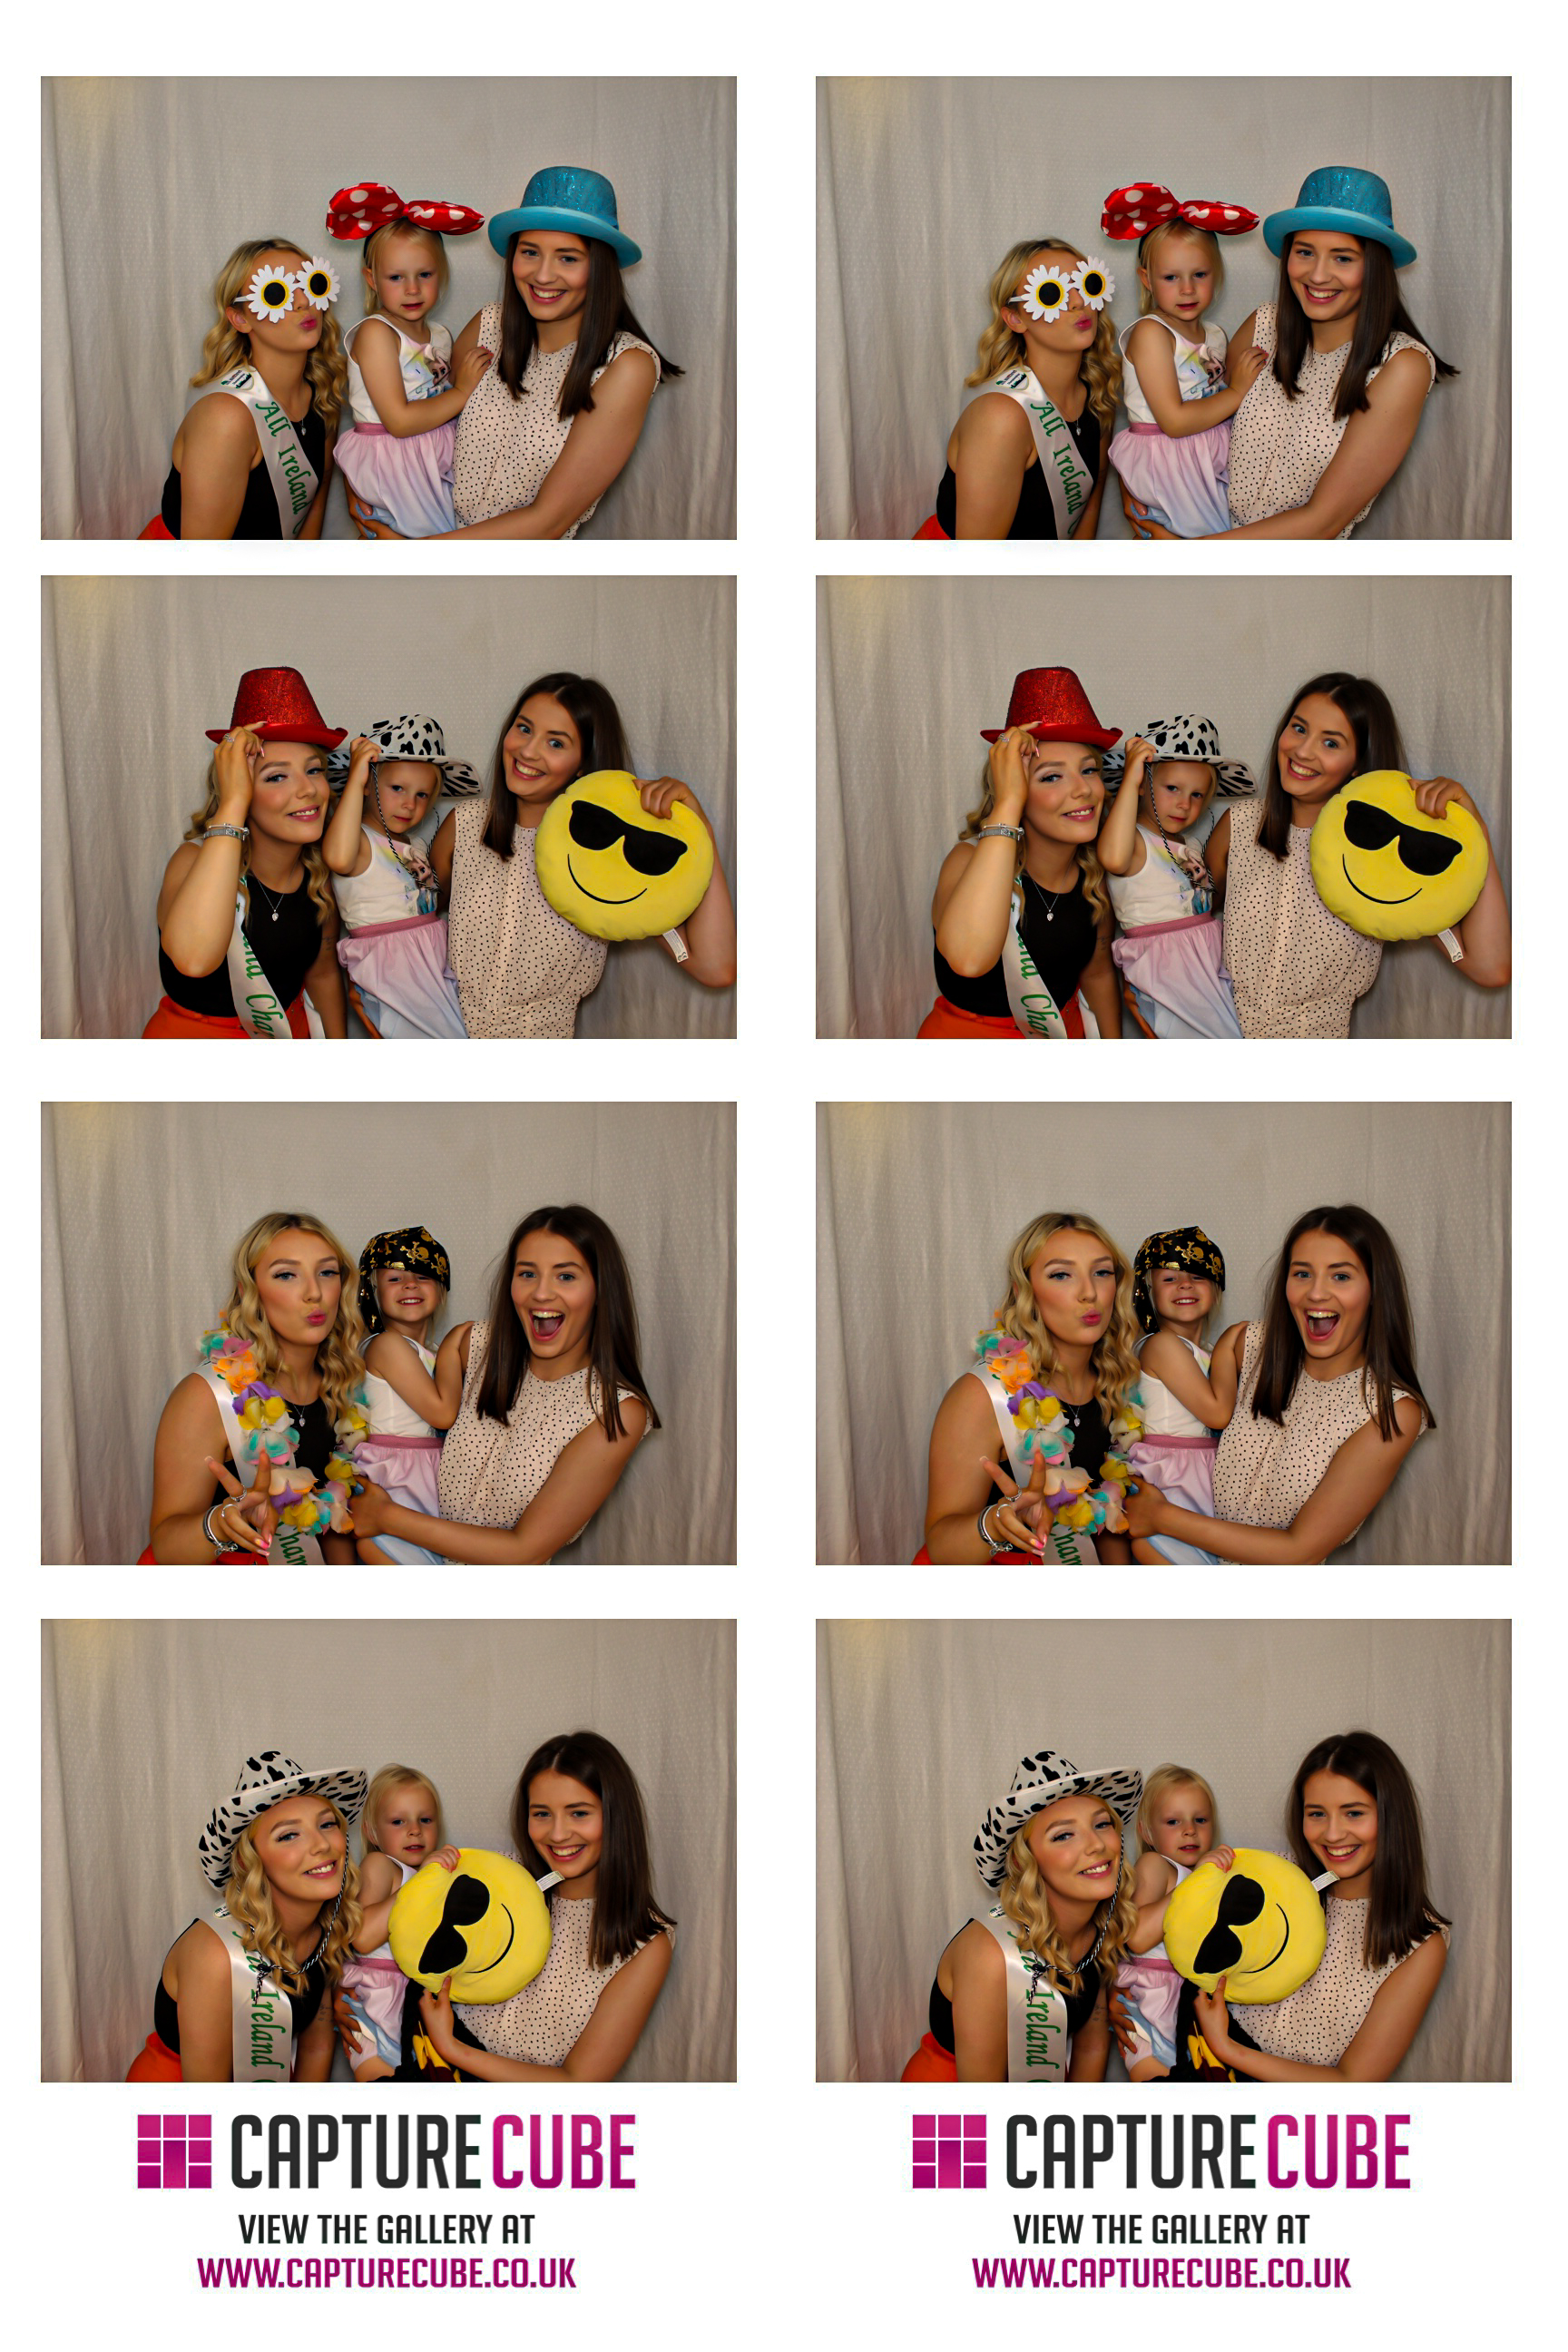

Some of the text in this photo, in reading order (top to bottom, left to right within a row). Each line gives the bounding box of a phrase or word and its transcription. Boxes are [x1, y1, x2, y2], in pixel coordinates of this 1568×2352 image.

[255, 401, 313, 515] All Ireland
[1030, 401, 1088, 515] All Ireland
[250, 1988, 287, 2070] Ireland
[1024, 1988, 1062, 2070] Ireland
